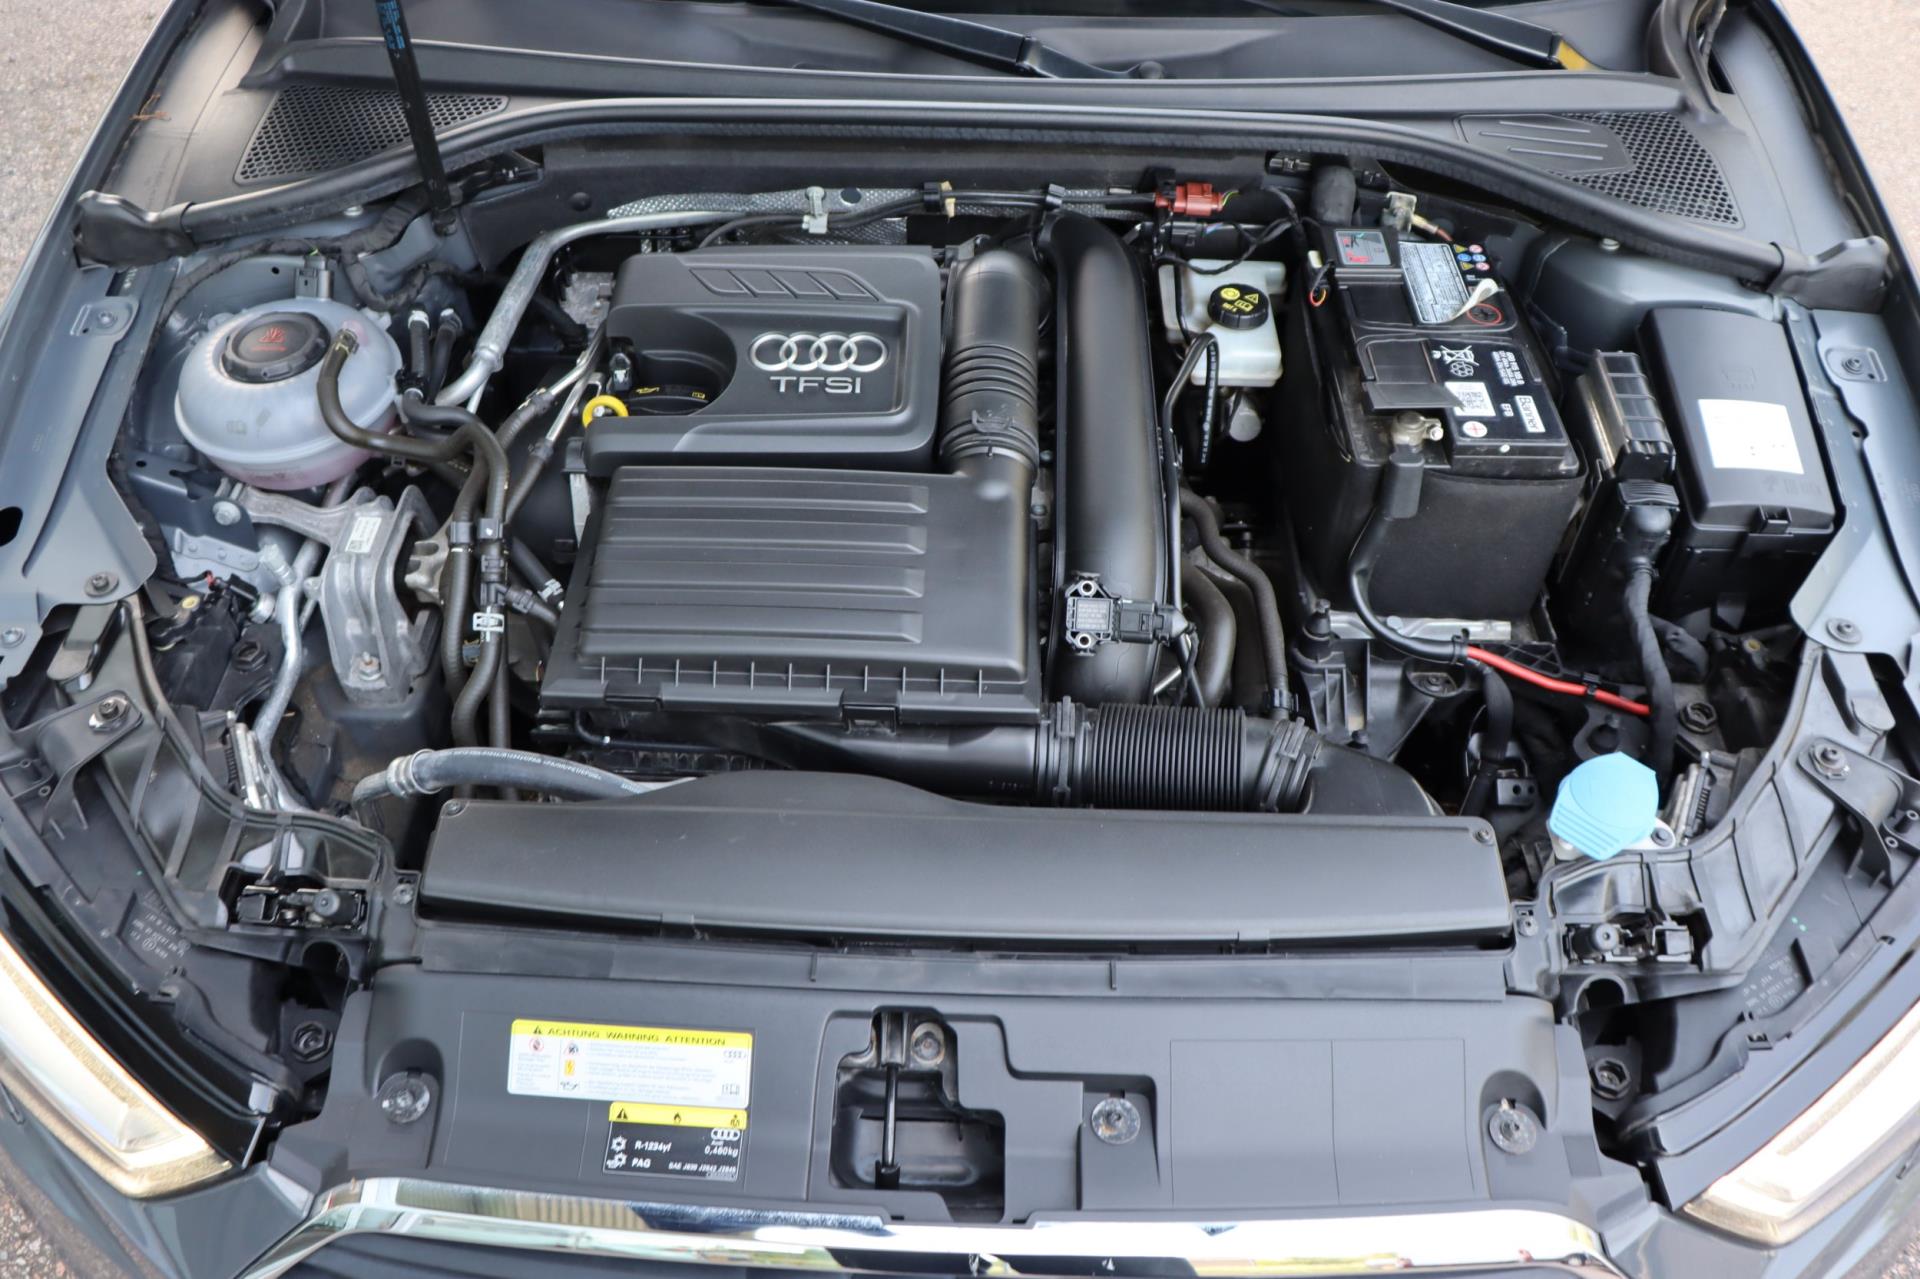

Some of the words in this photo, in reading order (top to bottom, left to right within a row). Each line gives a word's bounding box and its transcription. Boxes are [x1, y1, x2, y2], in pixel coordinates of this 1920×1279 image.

[770, 376, 861, 393] TFSI
[1519, 397, 1540, 430] Banner
[547, 1027, 600, 1039] ACHTUNG
[606, 1031, 659, 1042] WARNING
[665, 1035, 726, 1046] ATTENTION
[634, 1140, 672, 1153] R-1234yf
[631, 1157, 651, 1169] PAG
